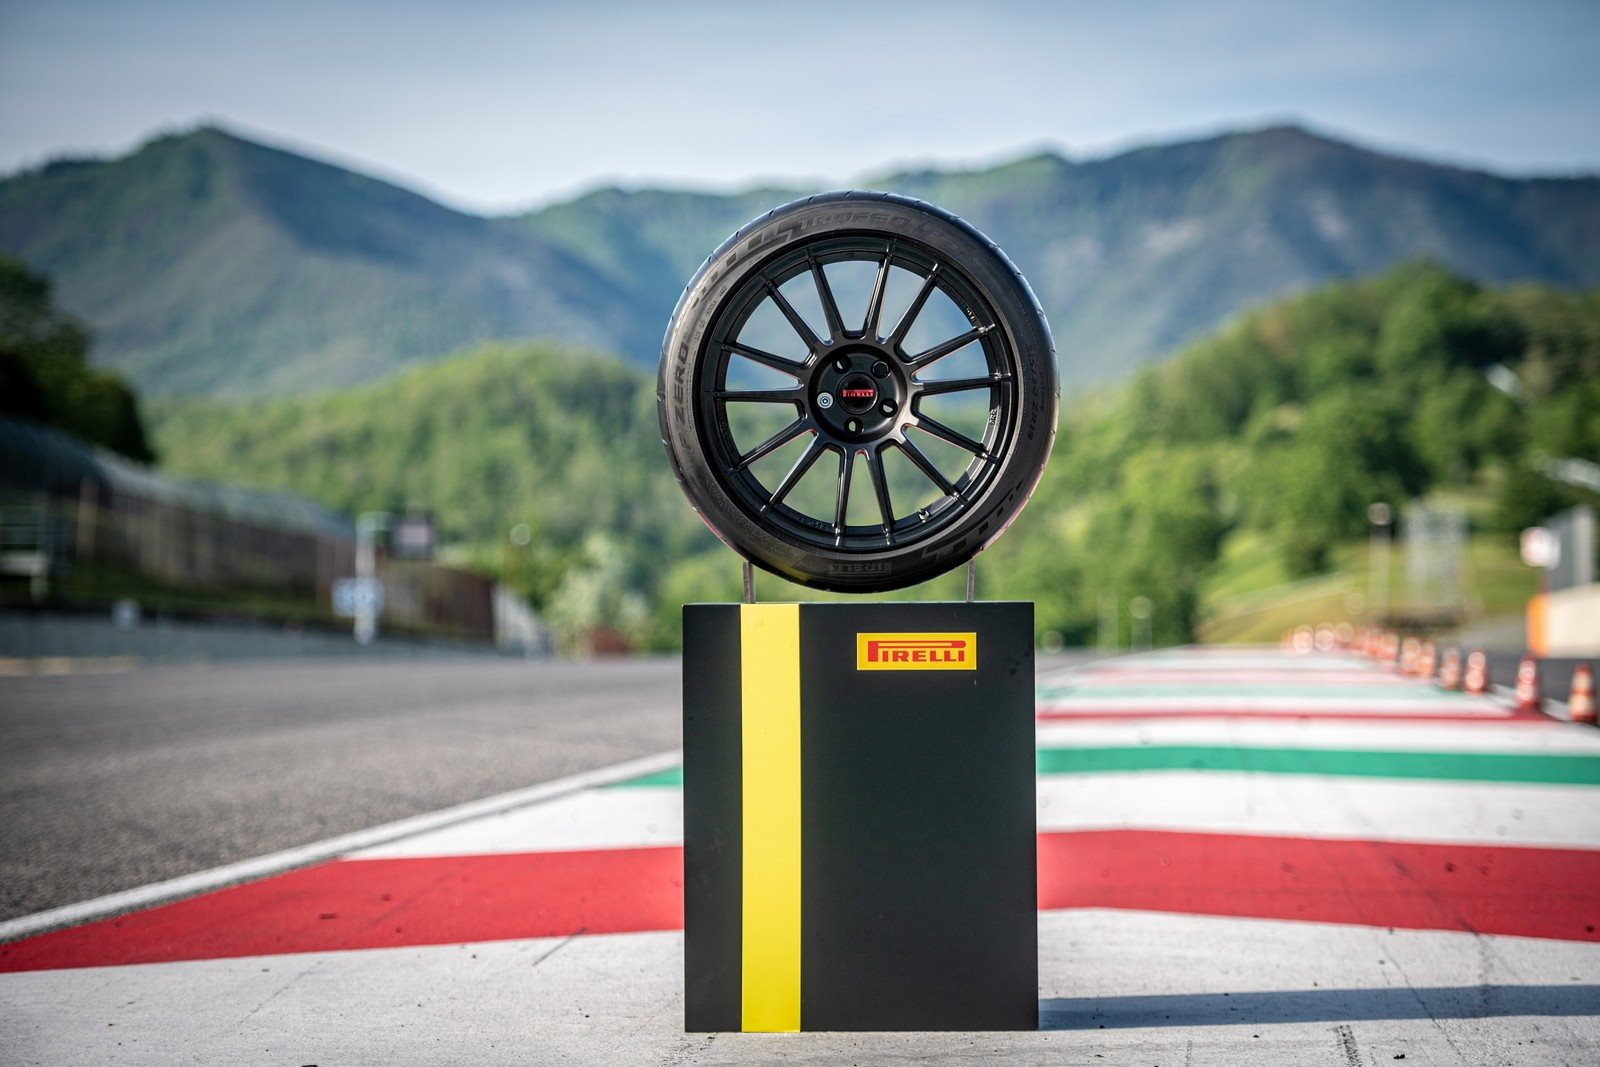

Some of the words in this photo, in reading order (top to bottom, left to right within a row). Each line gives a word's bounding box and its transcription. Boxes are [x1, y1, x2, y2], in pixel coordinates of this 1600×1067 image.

[674, 342, 690, 425] ZERO
[843, 389, 873, 397] PIRELLI
[868, 641, 966, 662] PIRELLI
